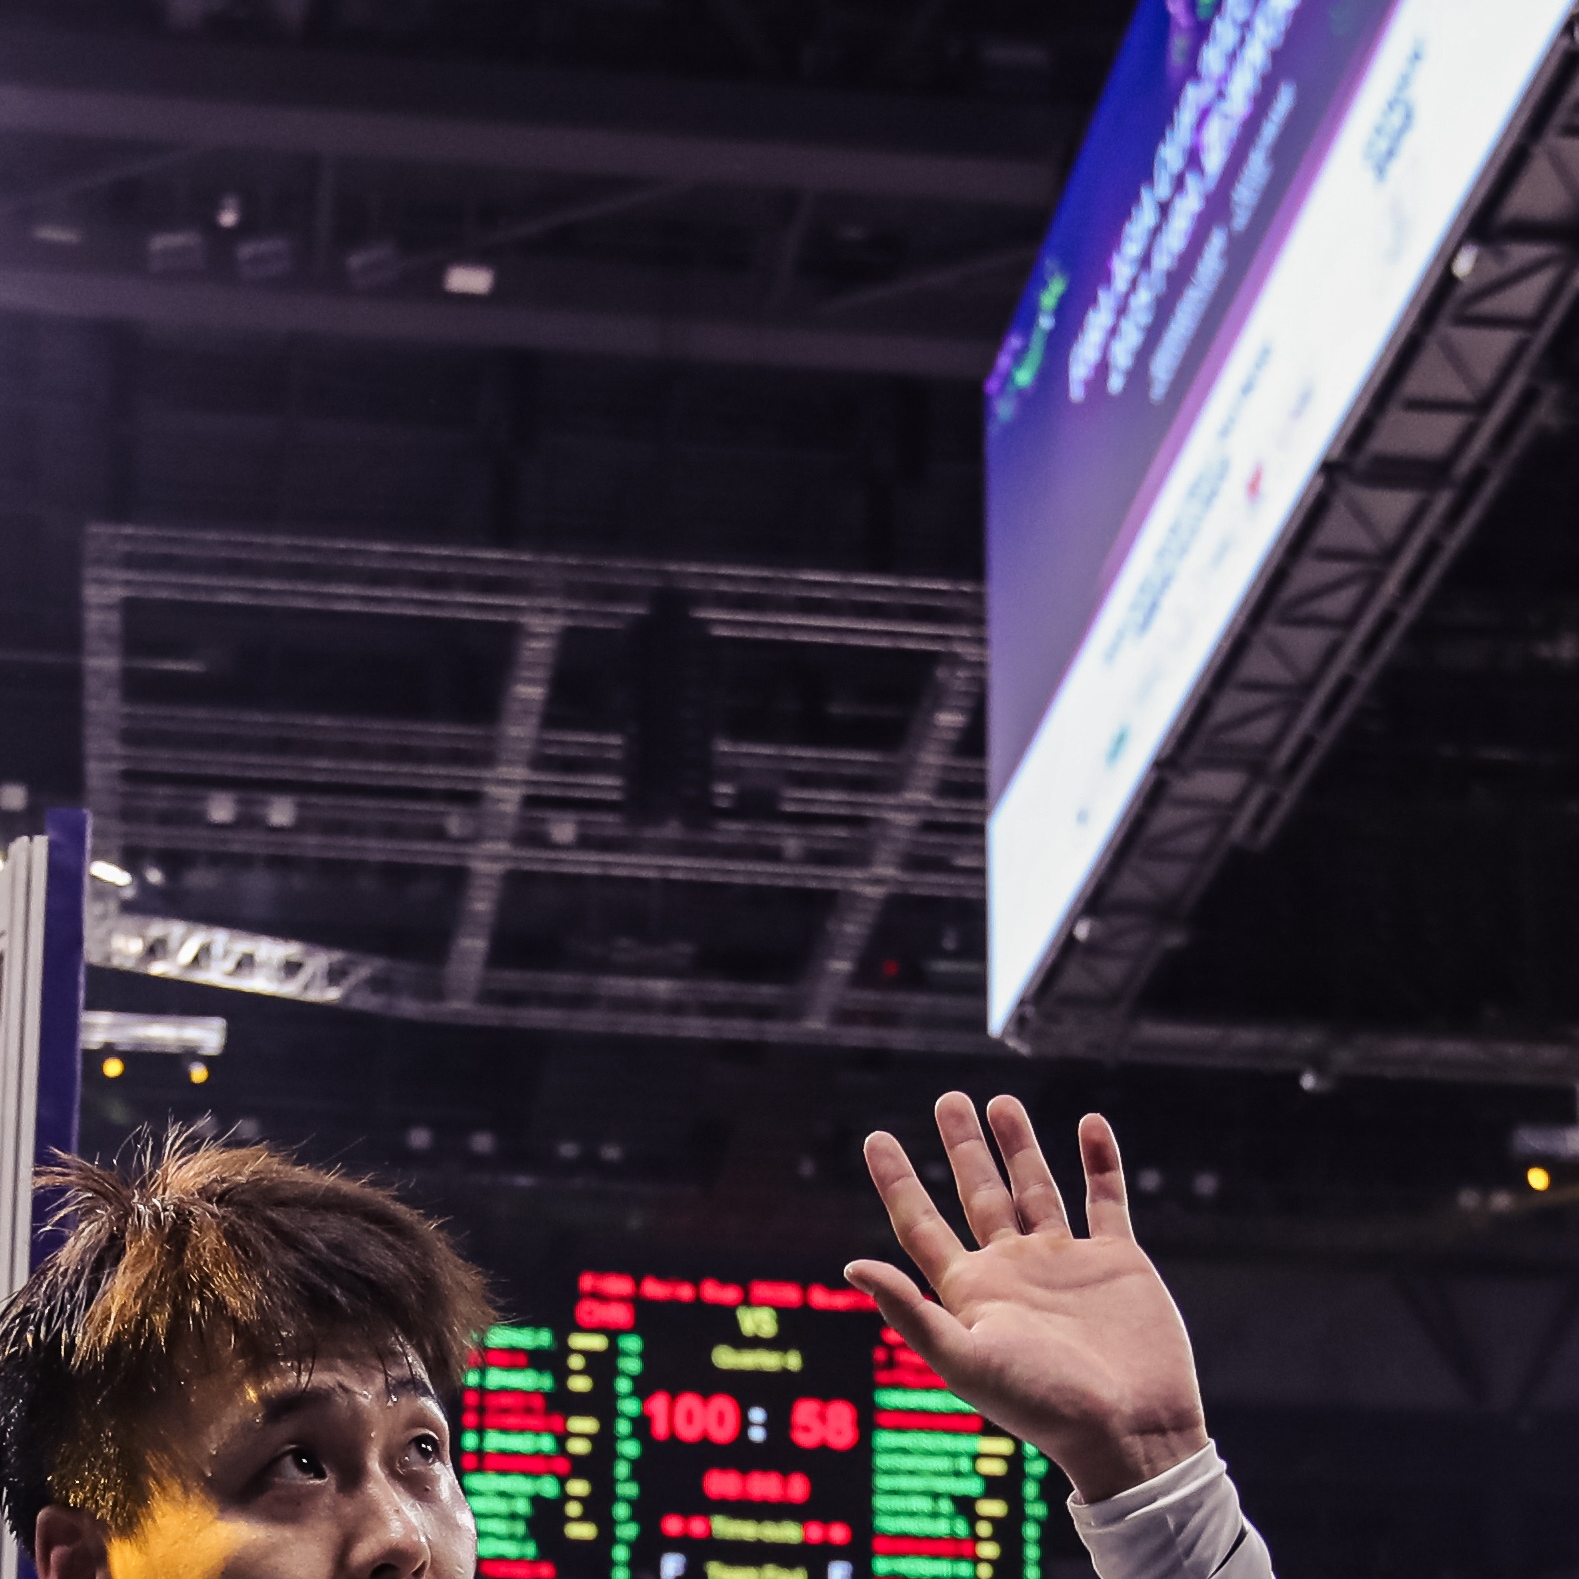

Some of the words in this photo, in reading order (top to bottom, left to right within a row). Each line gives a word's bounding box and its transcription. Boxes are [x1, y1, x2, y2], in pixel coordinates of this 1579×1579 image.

[735, 1305, 779, 1339] VS
[642, 1389, 742, 1445] 100
[789, 1397, 860, 1451] 58
